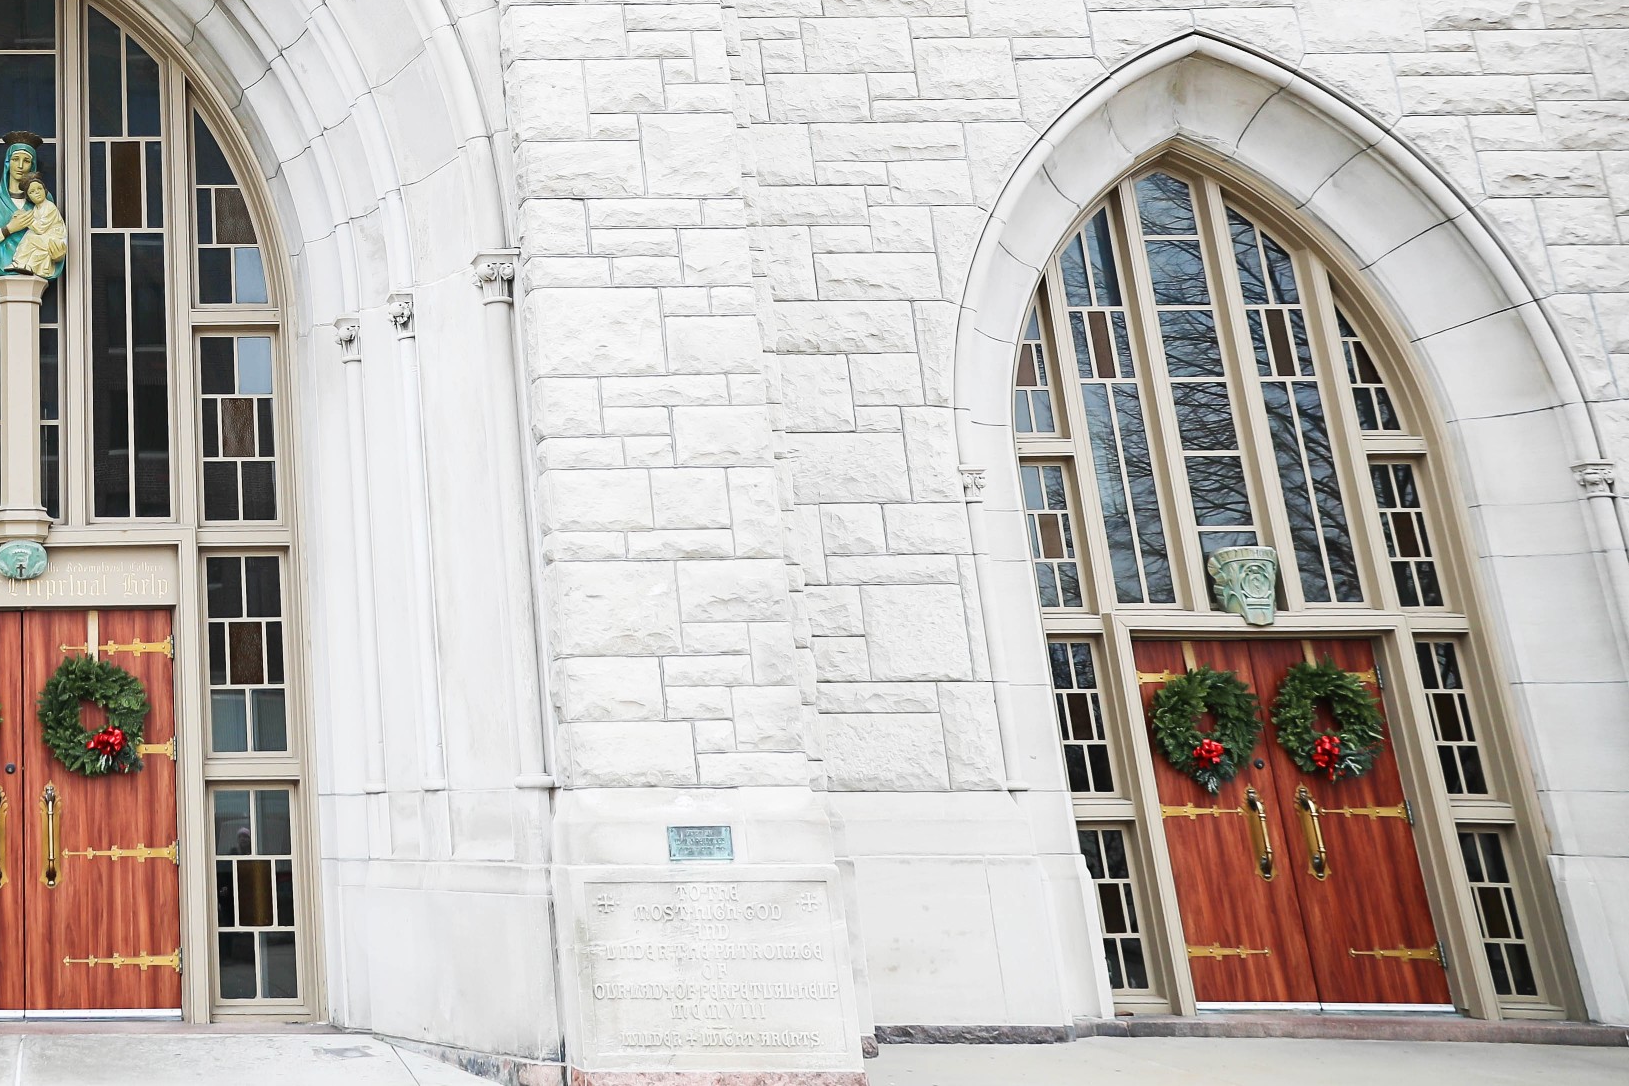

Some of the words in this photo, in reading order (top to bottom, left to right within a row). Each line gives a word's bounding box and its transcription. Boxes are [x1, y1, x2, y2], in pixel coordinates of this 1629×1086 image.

[122, 573, 170, 598] Help
[675, 885, 700, 902] TO
[633, 904, 689, 923] MOST
[743, 904, 782, 922] GOD
[712, 943, 823, 962] PATRONAGE
[700, 962, 728, 981] OF
